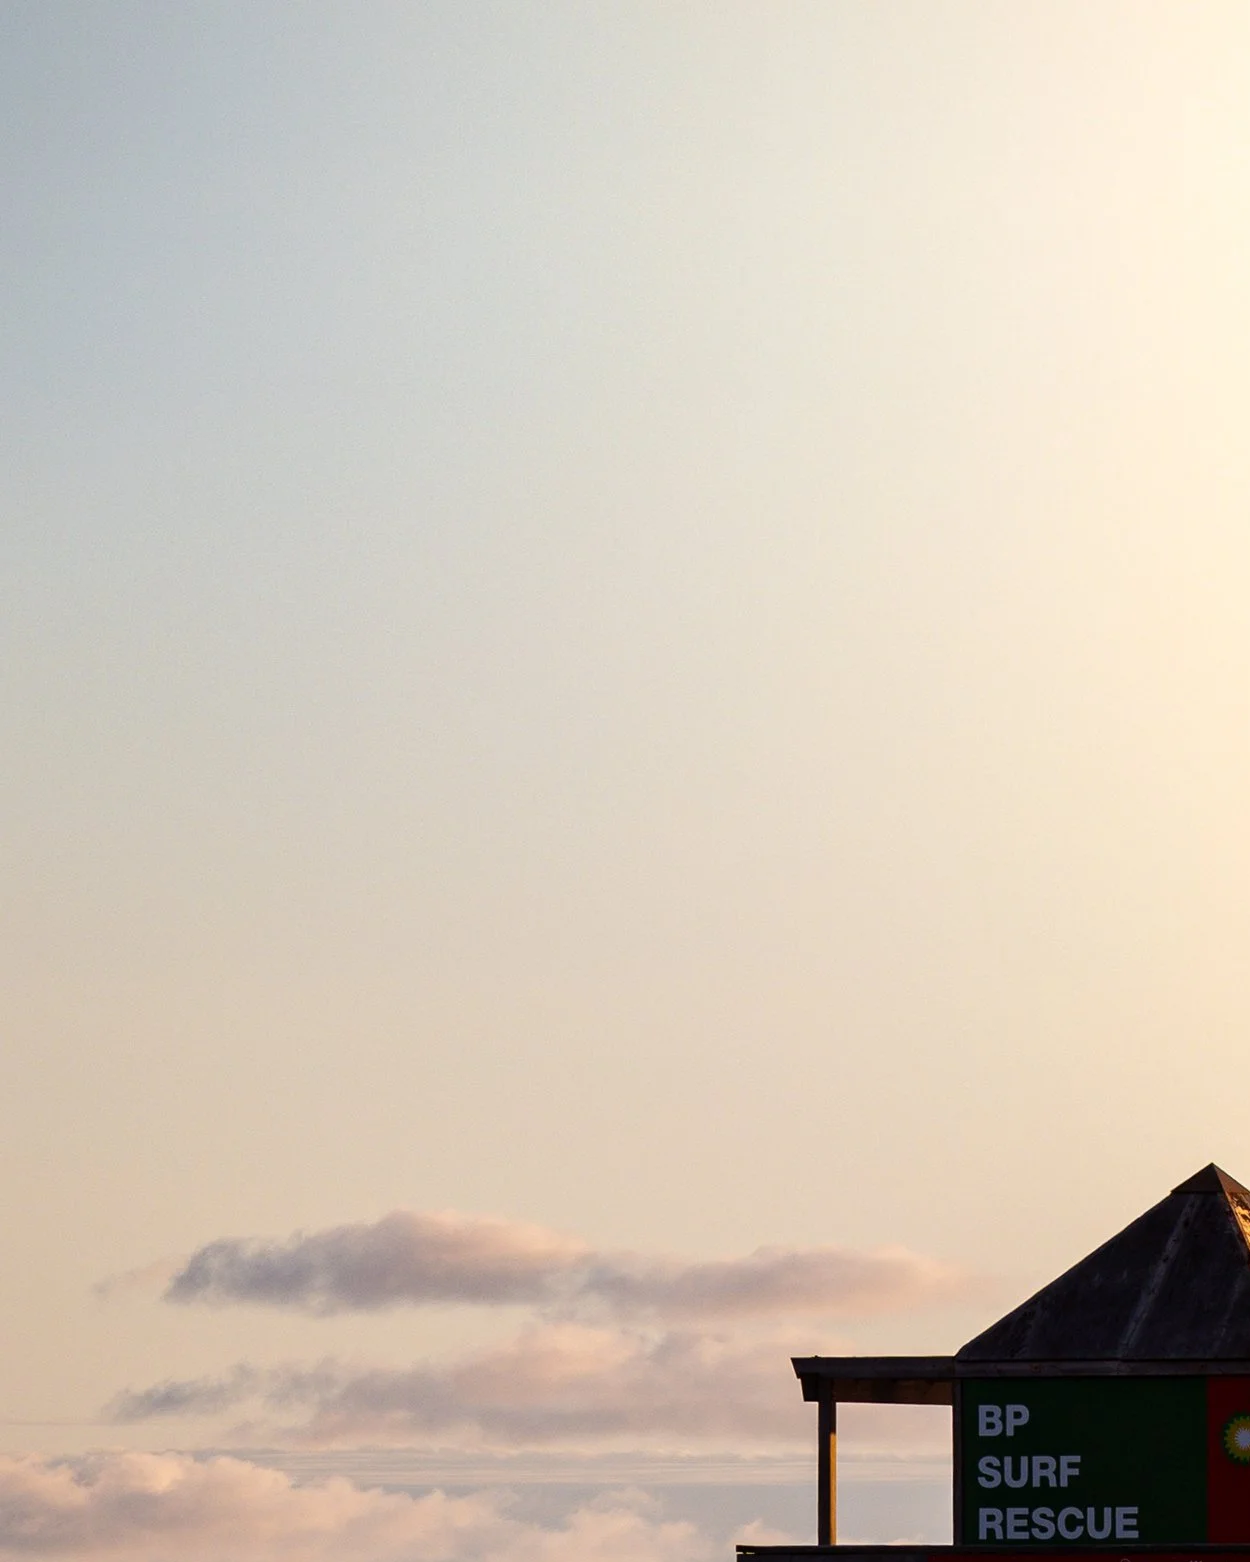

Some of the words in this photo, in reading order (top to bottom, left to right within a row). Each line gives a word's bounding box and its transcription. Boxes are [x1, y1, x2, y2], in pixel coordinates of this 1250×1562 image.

[977, 1404, 1030, 1437] BP
[977, 1455, 1082, 1489] SURF
[978, 1506, 1139, 1541] RESCUE
